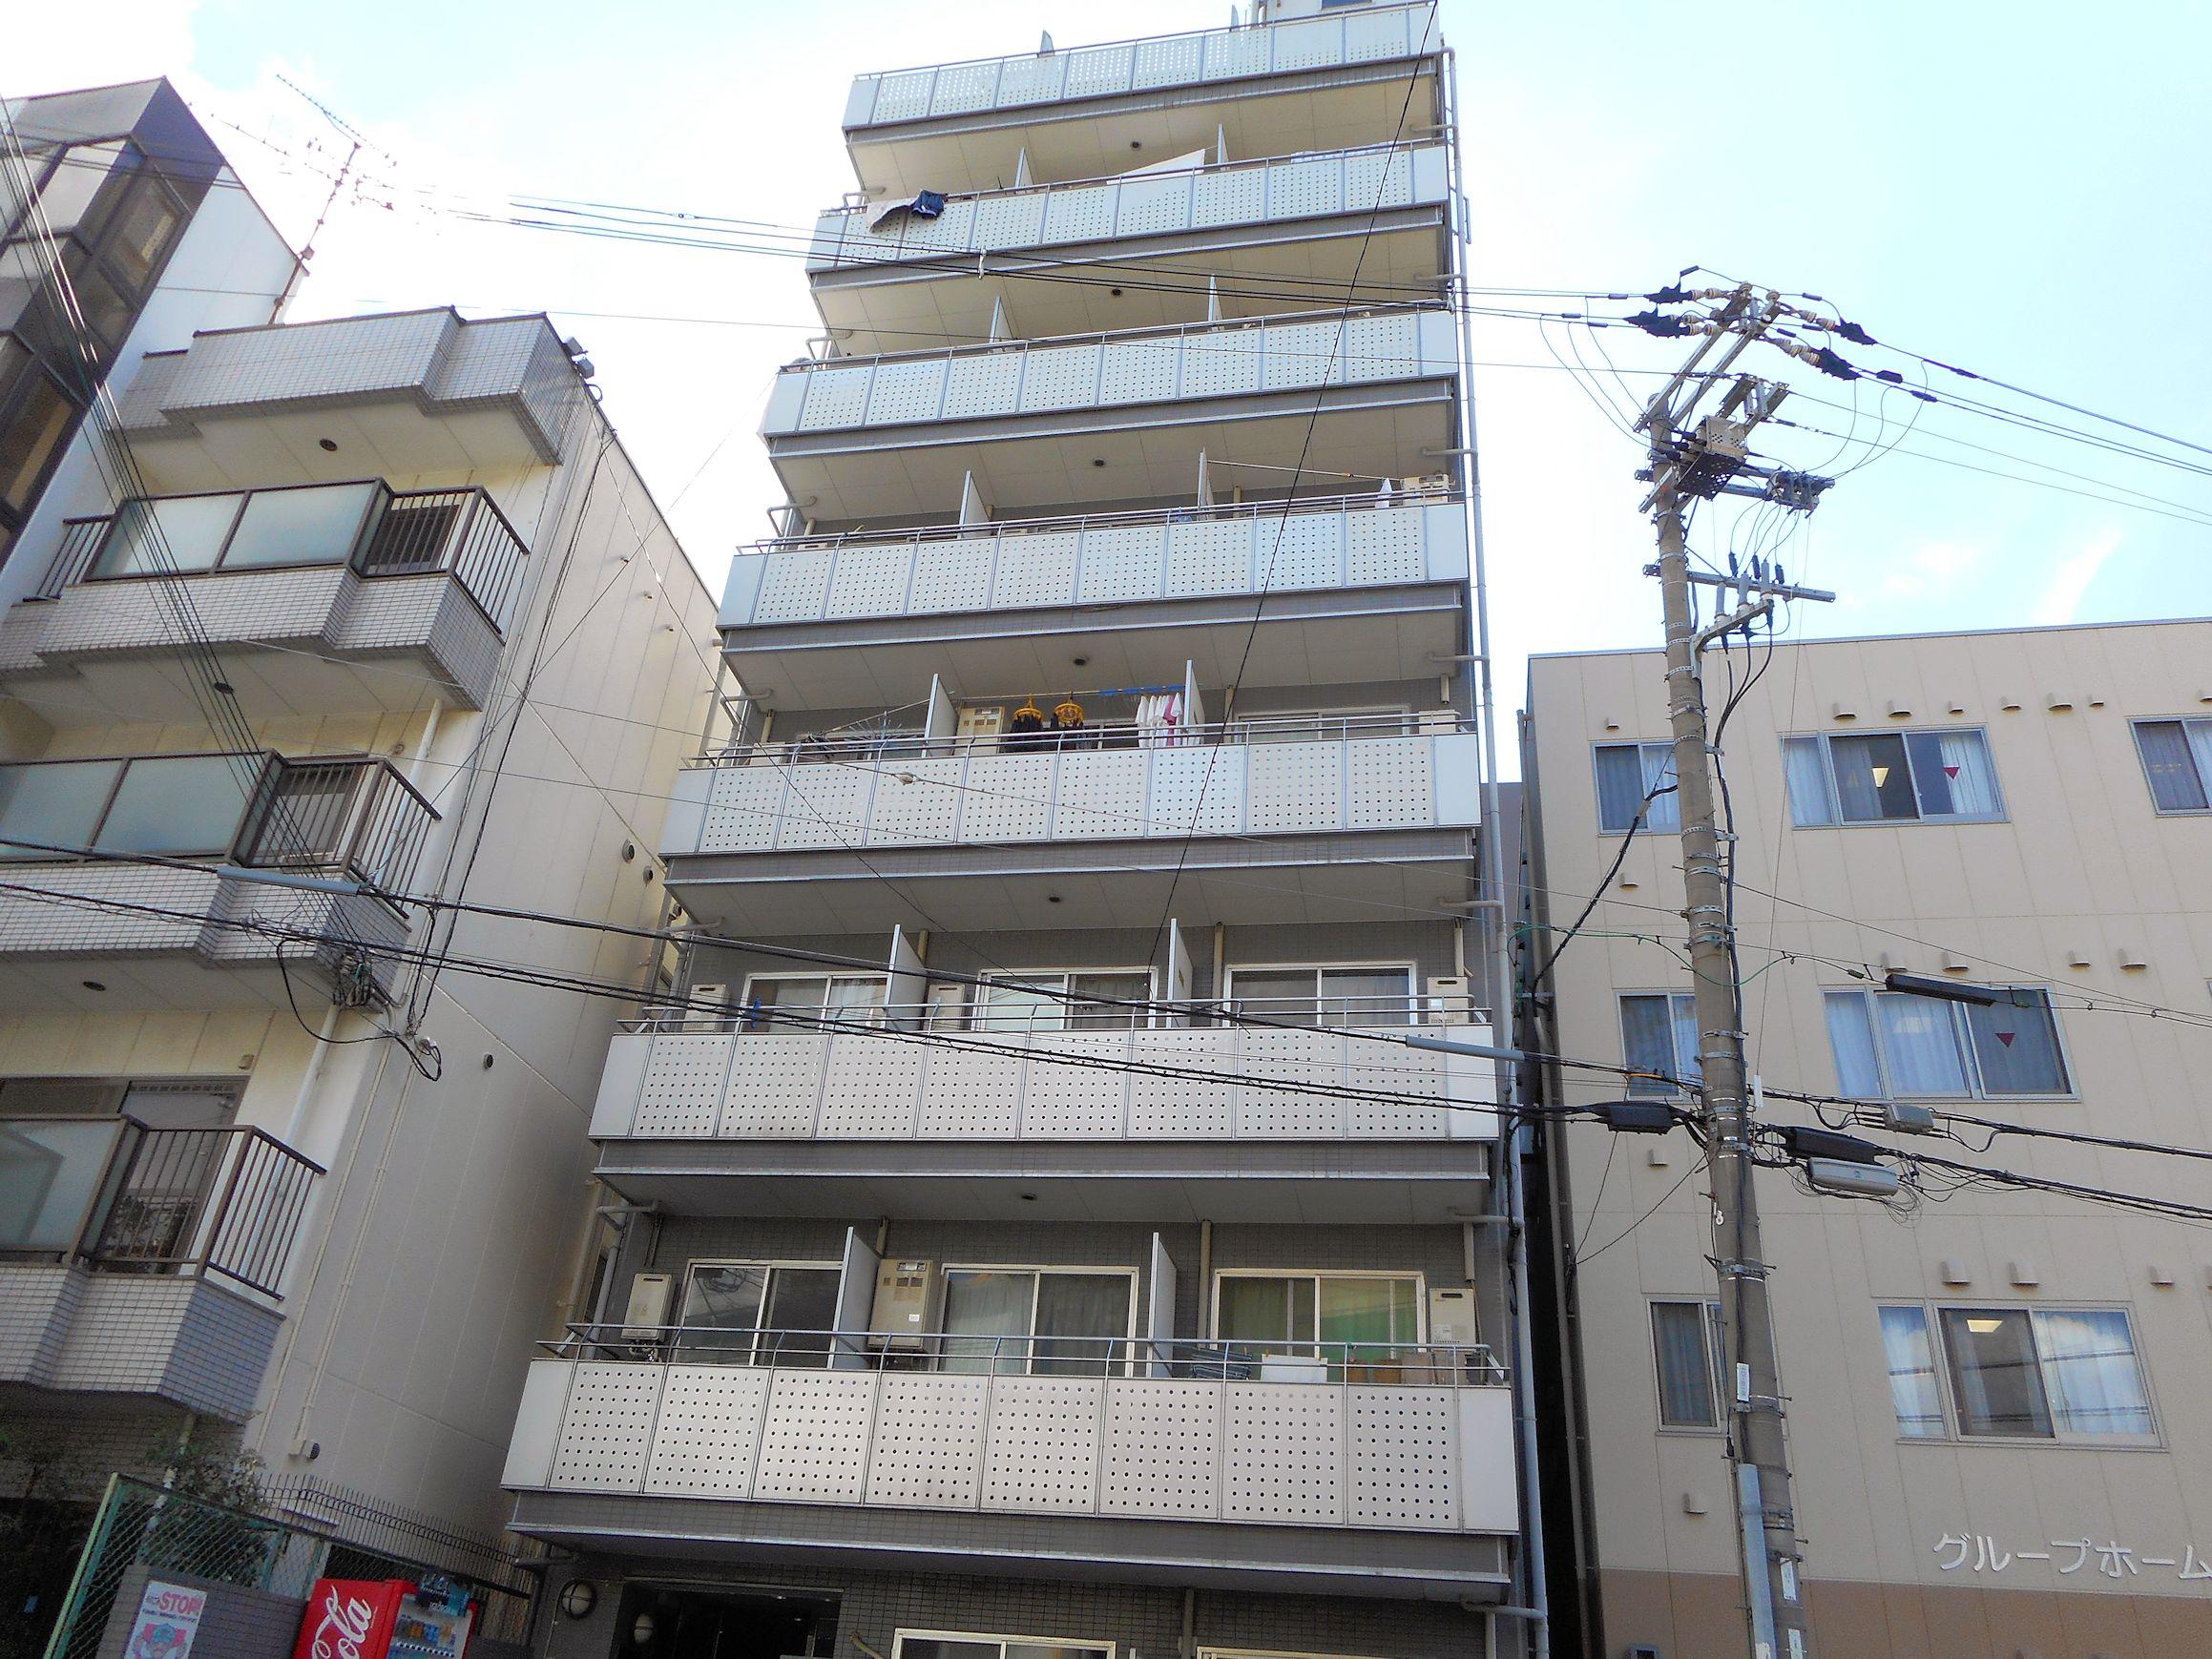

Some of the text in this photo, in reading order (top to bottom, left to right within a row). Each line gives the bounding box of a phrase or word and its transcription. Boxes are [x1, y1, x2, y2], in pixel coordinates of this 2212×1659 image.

[1932, 1533, 2212, 1579] グループホーム
